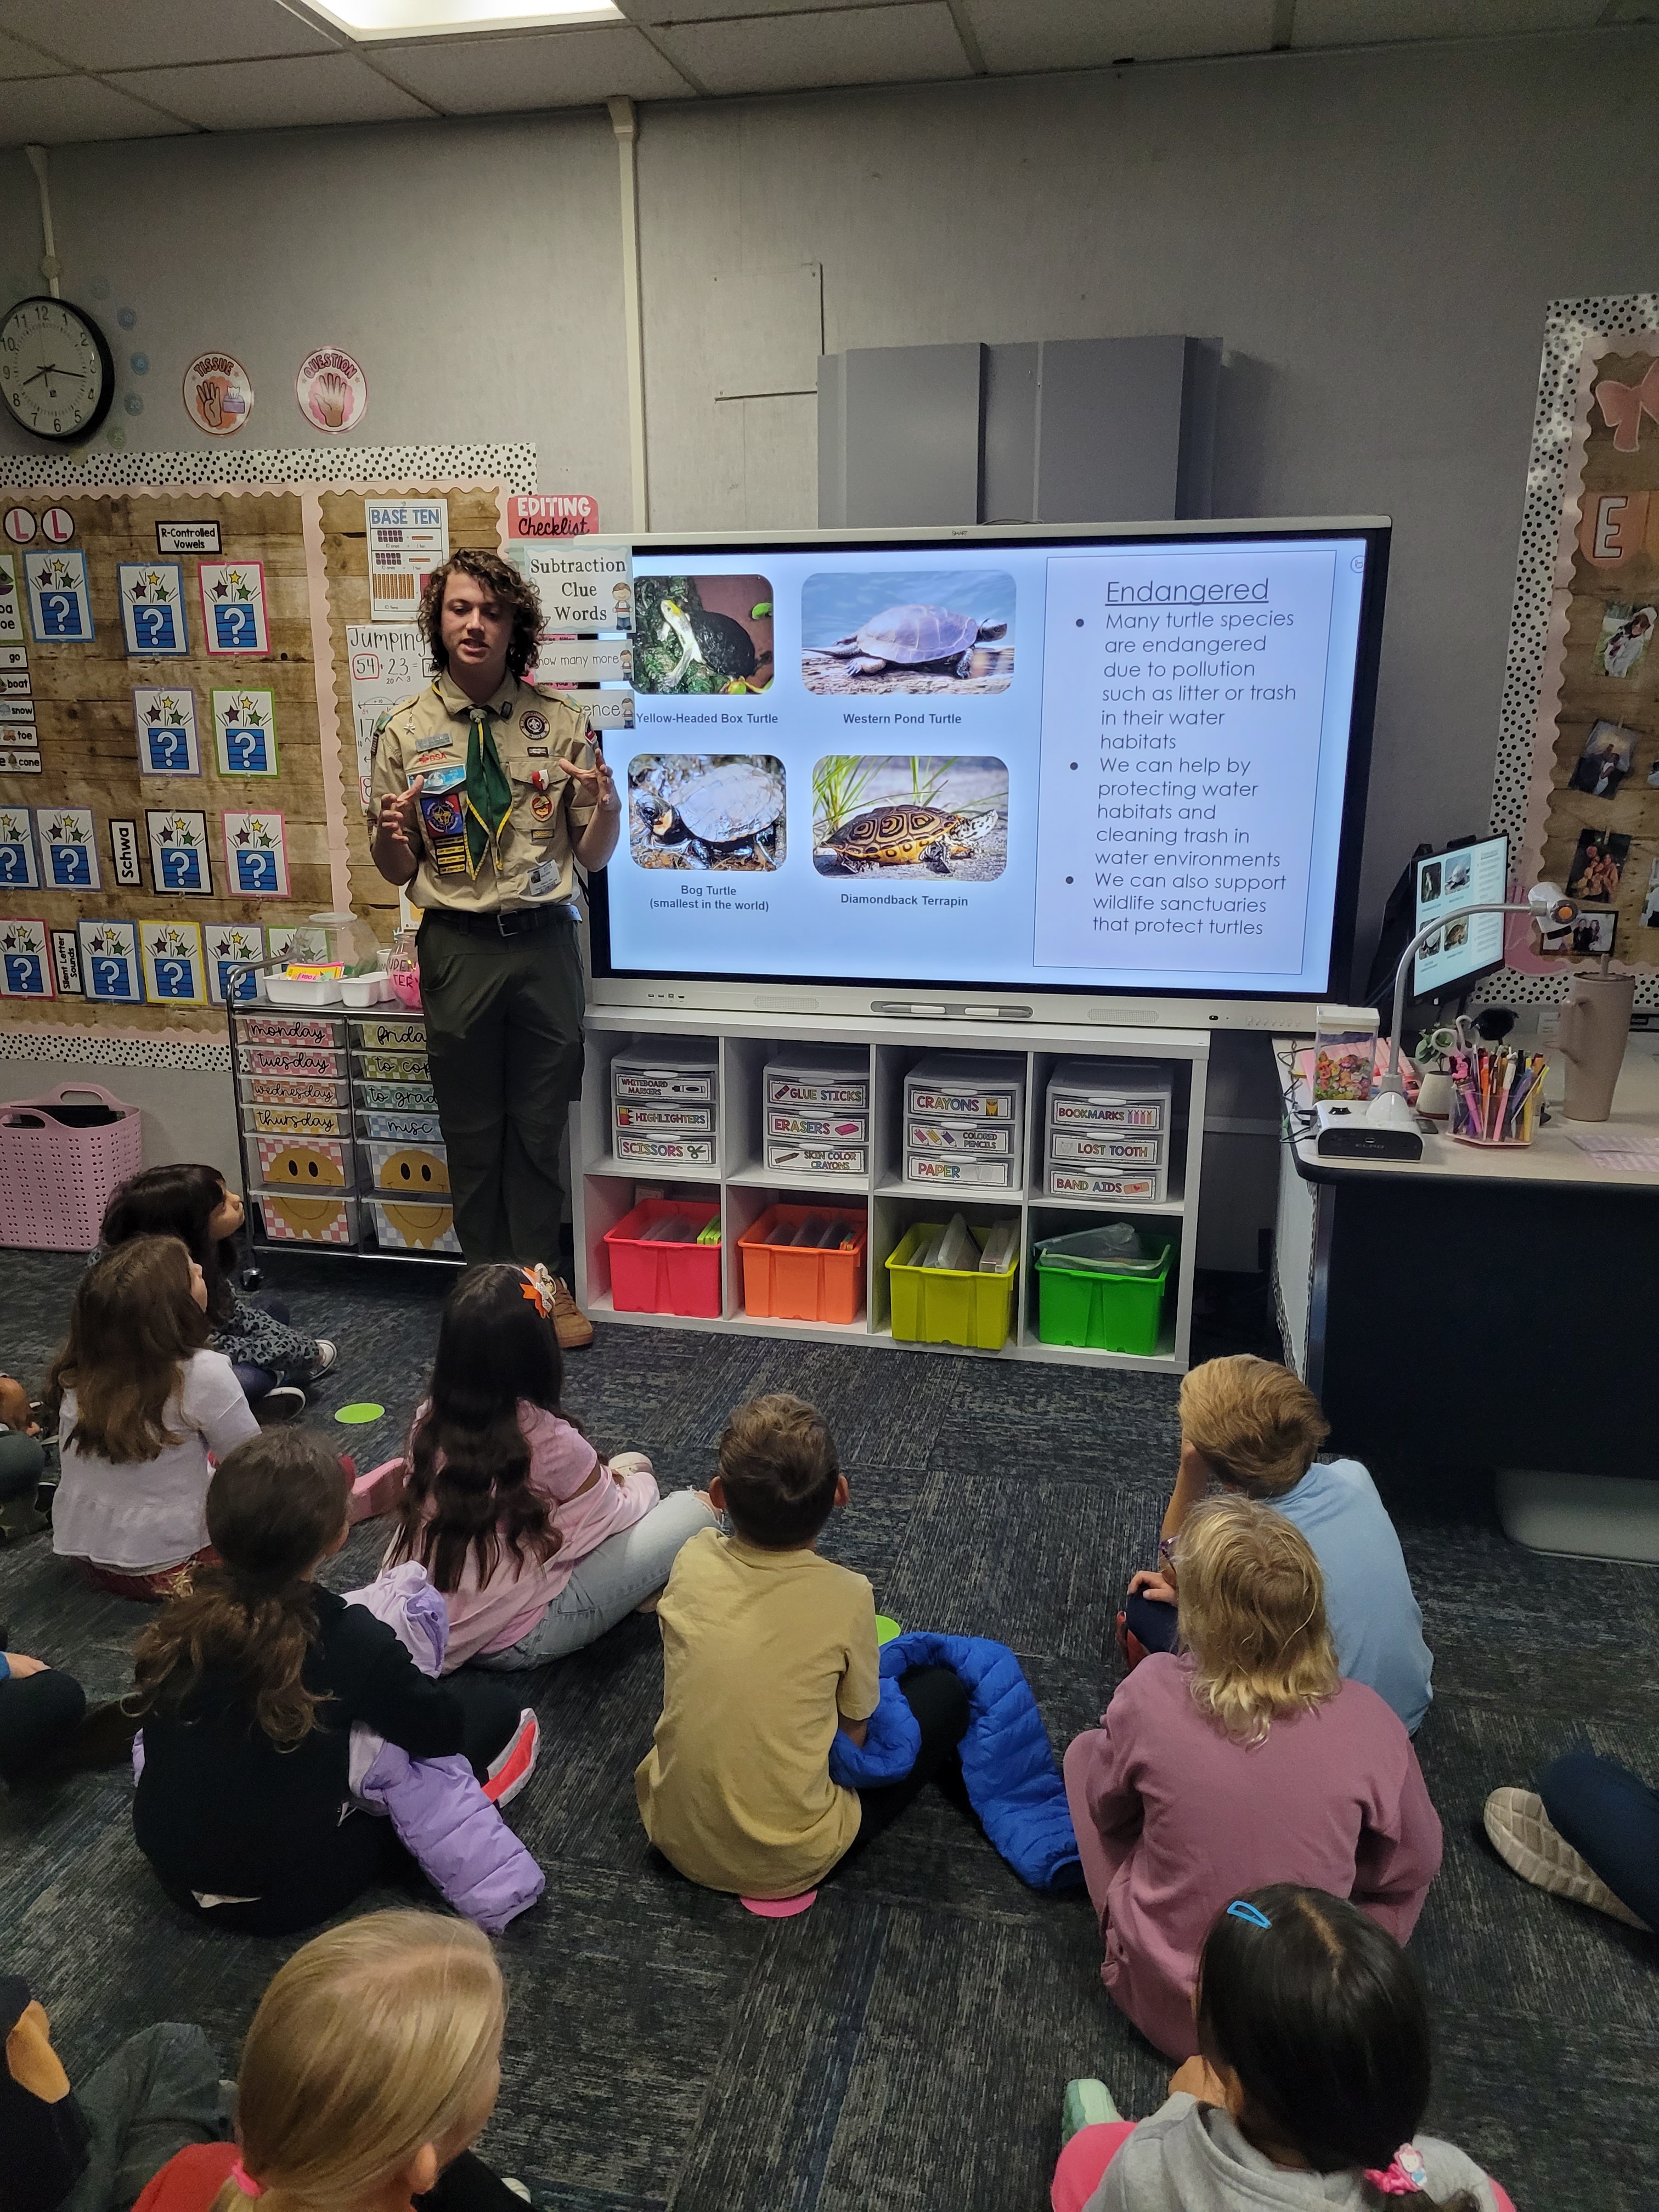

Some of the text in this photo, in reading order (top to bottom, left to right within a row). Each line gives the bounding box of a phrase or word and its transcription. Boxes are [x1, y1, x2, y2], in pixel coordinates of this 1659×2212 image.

[35, 306, 48, 320] 12
[63, 313, 67, 325] 1
[14, 314, 26, 328] 11
[0, 337, 14, 352] 10
[81, 332, 88, 346] 2
[3, 365, 10, 379] 9
[194, 357, 234, 377] TISSUE
[304, 353, 357, 379] QUESTION
[13, 393, 20, 407] 8
[31, 413, 37, 426] 7
[75, 410, 81, 423] 5
[54, 419, 61, 432] 6
[518, 497, 591, 517] EDITING
[371, 509, 439, 524] BASE TEN
[161, 528, 215, 538] R-Controlled
[518, 517, 590, 536] Checklist
[1593, 496, 1628, 558] E
[174, 539, 205, 549] Vowels
[531, 557, 626, 573] Subtraction
[562, 582, 597, 597] Clue
[1108, 578, 1269, 604] Endangered
[554, 605, 607, 621] Words
[1107, 611, 1294, 631] Many turtle species
[348, 627, 426, 657] Jumping
[1105, 635, 1266, 655] are endangered
[9, 653, 20, 663] go
[561, 656, 588, 668] many
[592, 655, 619, 664] more
[357, 658, 374, 674] 54
[388, 658, 409, 675] 23
[1104, 661, 1254, 680] due to pollution
[7, 679, 28, 688] boat
[1103, 685, 1295, 701] such as litter or trash
[636, 713, 778, 723] Yellow-Headed Box Turtle
[843, 714, 961, 723] Western Pond Turtle
[1102, 710, 1224, 725] in their water
[17, 731, 32, 740] toe
[360, 719, 374, 737] 17
[1101, 734, 1175, 749] habitats
[430, 752, 447, 761] BSA
[1101, 758, 1250, 776] We can help by
[1099, 781, 1259, 799] protecting water
[1098, 804, 1215, 819] habitats and
[1097, 827, 1249, 845] cleaning trash in
[119, 828, 134, 878] Schwa
[1096, 850, 1280, 867] water environments
[681, 885, 736, 896] Bog Turtle
[1096, 873, 1286, 893] We can also support
[650, 899, 769, 912] (smallest in the world)
[842, 894, 967, 907] Diamondback Terrapin
[1093, 895, 1266, 912] wildlife sanctuaries
[1093, 917, 1262, 935] that protect turtles
[59, 935, 70, 989] Silent Letter
[67, 947, 77, 978] Sounds
[251, 1022, 325, 1043] monday
[377, 1026, 427, 1045] frida
[257, 1052, 329, 1074] tuesday
[375, 1057, 394, 1072] to
[622, 1079, 668, 1087] WHITEBOARD
[255, 1084, 333, 1102] wednesday
[369, 1087, 388, 1102] to
[628, 1087, 662, 1095] MARKERS
[790, 1088, 861, 1102] GLUE STICKS
[917, 1096, 979, 1111] CRAYONS
[256, 1110, 335, 1132] thursday
[635, 1113, 706, 1124] HIGHLIGHTERS
[1059, 1108, 1124, 1121] BOOKMARKS
[775, 1119, 830, 1135] ERASERS
[963, 1132, 997, 1141] COLORED
[623, 1142, 683, 1157] SCISSORS
[964, 1141, 996, 1149] PENCILS
[1077, 1143, 1148, 1157] LOST TOOTH
[804, 1151, 856, 1160] SKIN COLOR
[811, 1161, 850, 1170] CRAYONS
[918, 1163, 960, 1178] PAPER
[1057, 1178, 1122, 1193] BAND AIDS
